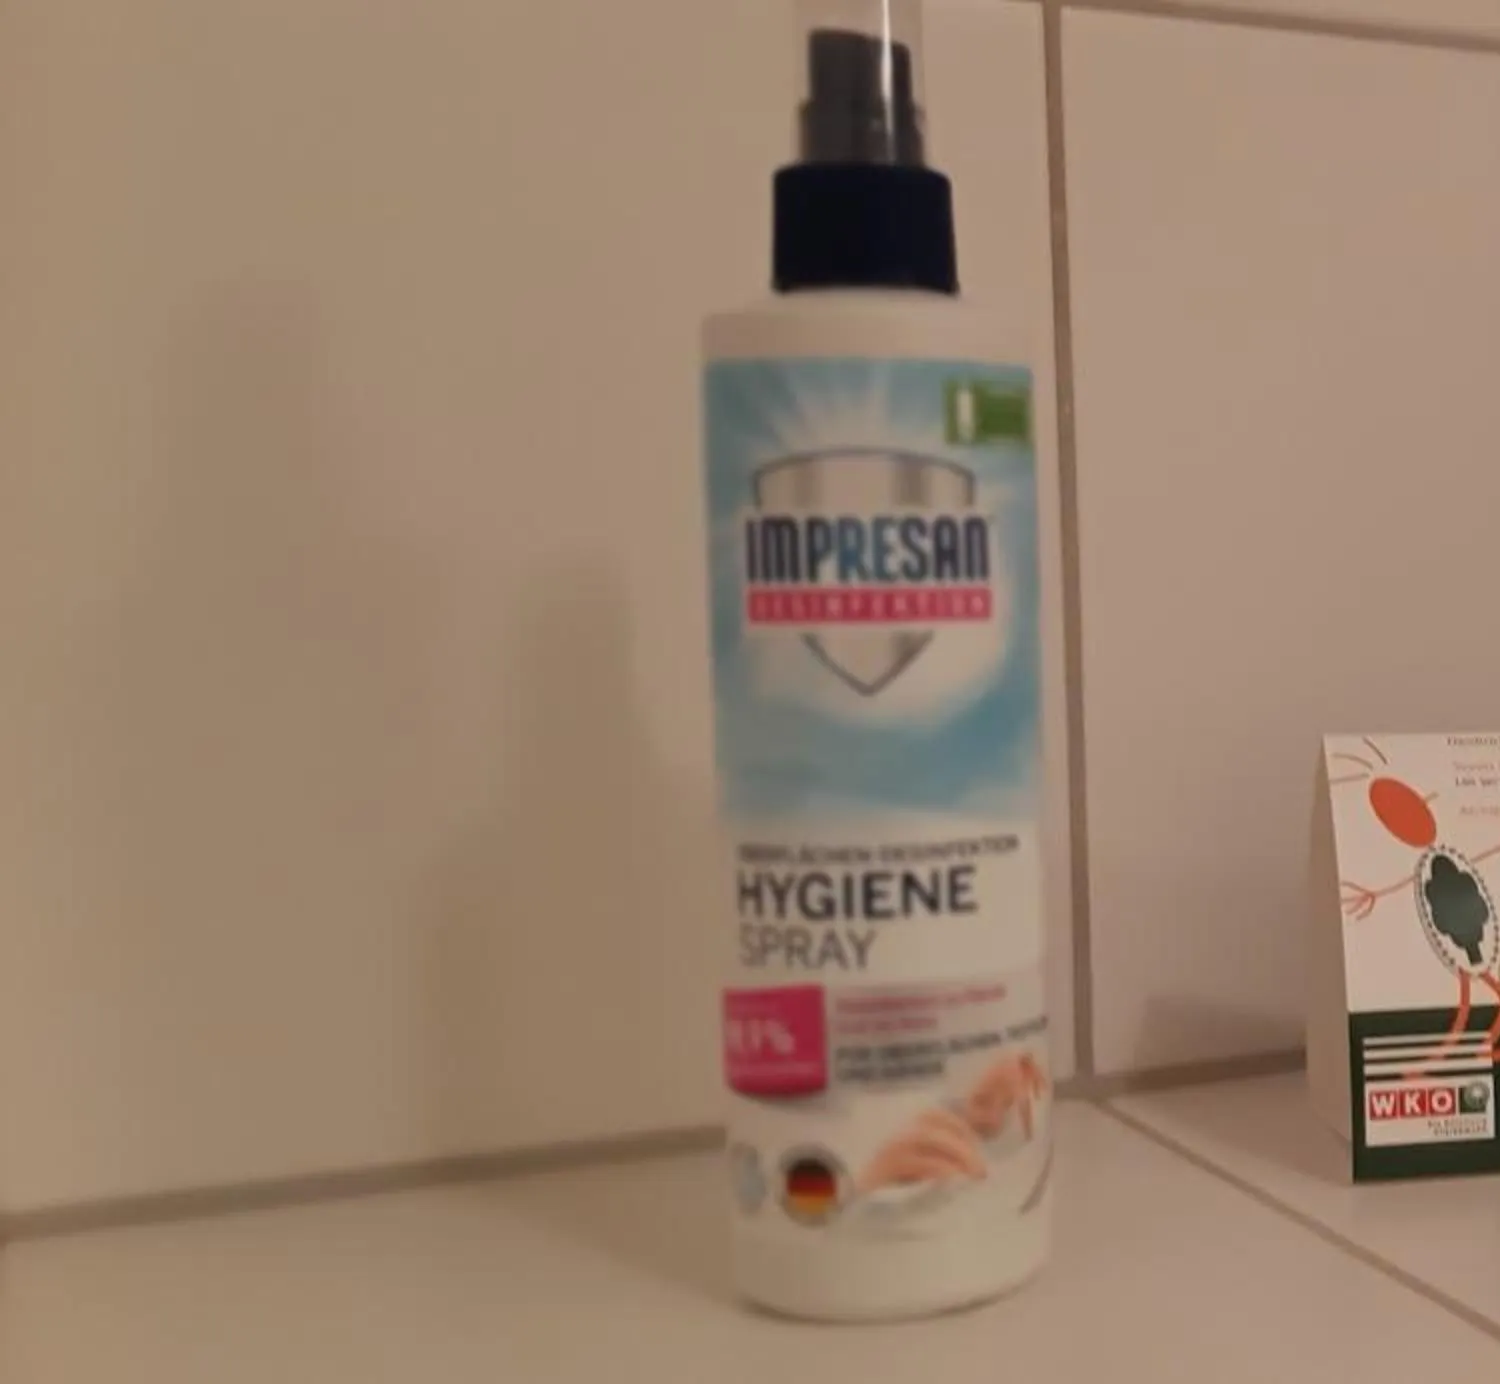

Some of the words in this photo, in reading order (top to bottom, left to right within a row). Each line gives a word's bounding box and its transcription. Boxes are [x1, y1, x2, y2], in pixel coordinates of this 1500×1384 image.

[746, 514, 990, 584] IMPRESAN
[737, 864, 979, 922] HYGIENE
[739, 922, 877, 971] SPRAY
[1371, 1089, 1453, 1117] WKO
